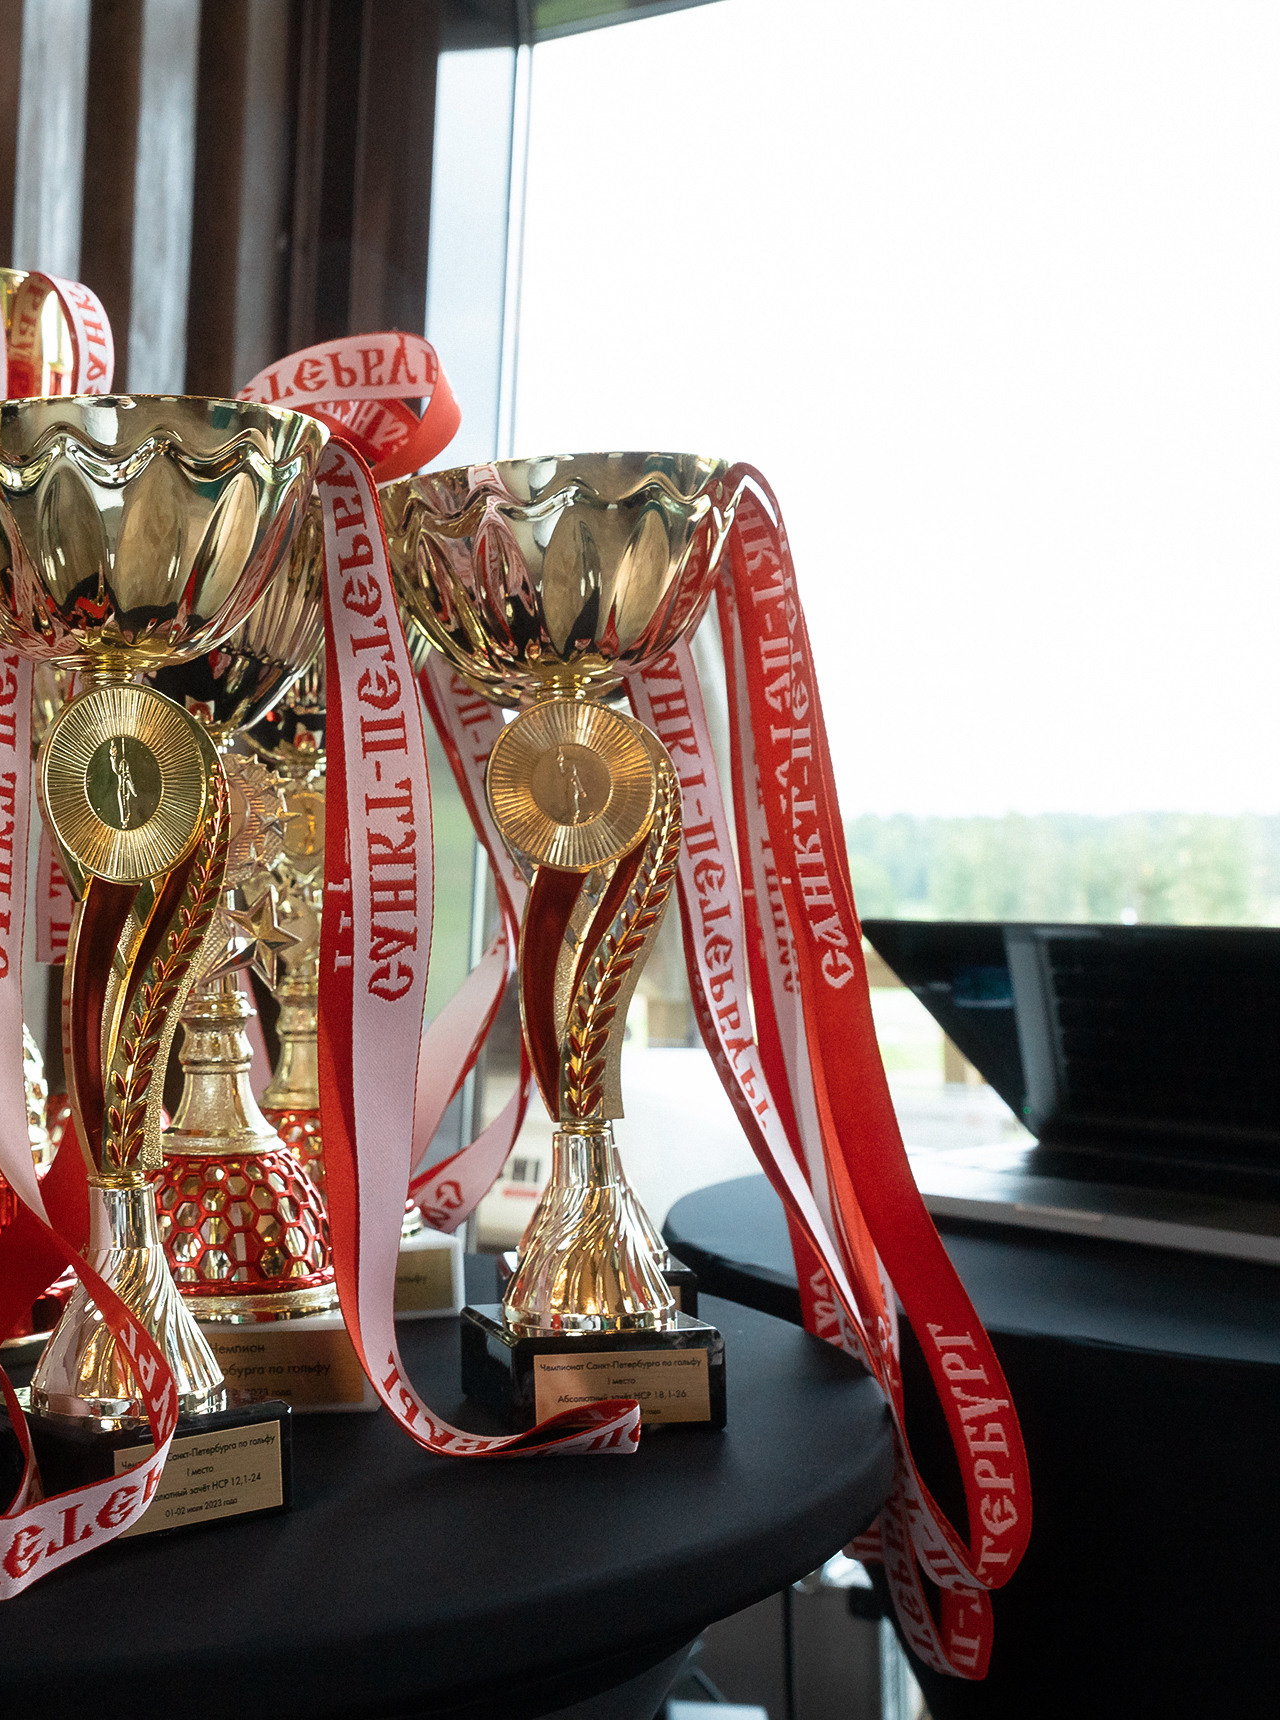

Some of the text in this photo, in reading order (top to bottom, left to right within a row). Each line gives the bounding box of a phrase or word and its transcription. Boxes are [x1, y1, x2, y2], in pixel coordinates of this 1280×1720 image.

[268, 1365, 284, 1375] по
[287, 1361, 331, 1376] гольфу
[539, 1363, 584, 1372] Чемпионат
[586, 1359, 661, 1371] Санкт-Петербурга
[673, 1357, 702, 1368] гольфу
[612, 1377, 636, 1385] место
[166, 1442, 238, 1463] Санкт-Петербурга
[238, 1439, 249, 1449] по
[249, 1434, 275, 1448] гольфу
[191, 1465, 214, 1476] место
[189, 1484, 211, 1497] зачёт
[231, 1472, 261, 1487] 12,1-24
[164, 1507, 186, 1518] 01-02
[204, 1500, 222, 1510] 2023
